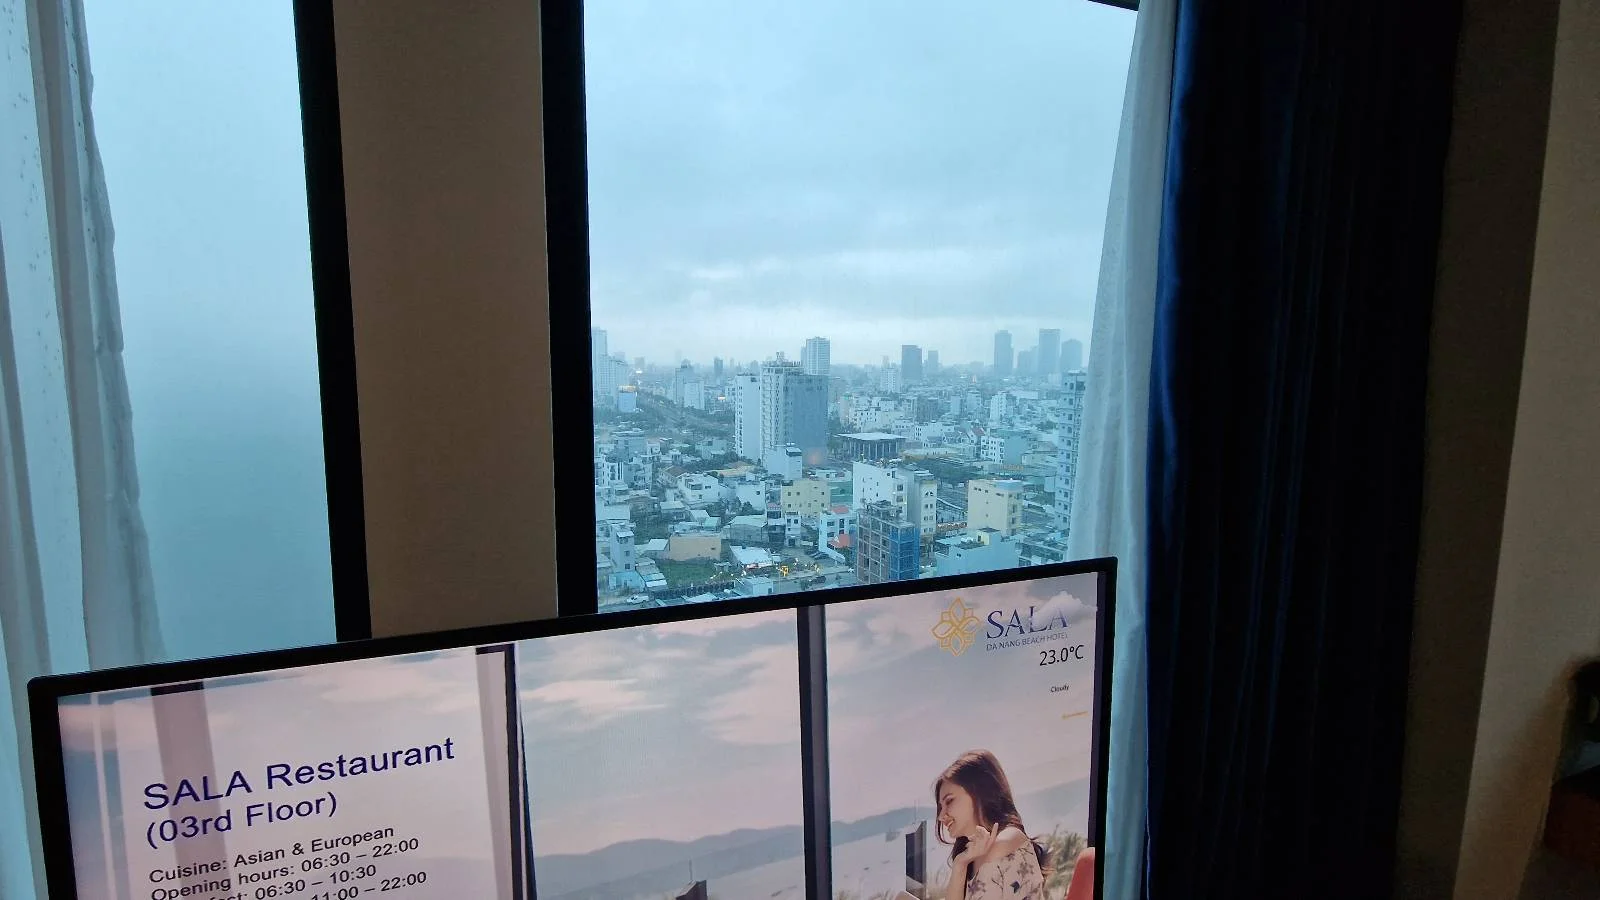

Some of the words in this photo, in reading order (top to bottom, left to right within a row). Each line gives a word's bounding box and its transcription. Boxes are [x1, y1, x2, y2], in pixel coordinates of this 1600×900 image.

[985, 605, 1069, 639] SALA
[985, 642, 998, 652] DA
[1000, 638, 1021, 650] NANG
[1023, 634, 1046, 646] BEACH
[1047, 631, 1068, 642] HOTEL
[1039, 644, 1085, 667] 23.0°C
[1050, 684, 1070, 694] Cloudy
[143, 770, 253, 810] SALA
[266, 737, 455, 790] Restaurant
[146, 808, 232, 850] (03rd
[246, 791, 337, 827] Floor)
[149, 860, 227, 883] Cuisine:
[233, 848, 285, 868] Asian
[291, 842, 305, 856] &
[310, 827, 395, 853] European
[151, 878, 231, 900] Opening
[238, 865, 295, 885] hours:
[301, 851, 351, 872] 06:30
[372, 837, 419, 858] 22:00
[255, 879, 306, 900] 06:30
[329, 864, 377, 884] 10:30
[380, 871, 427, 892] 22:00
